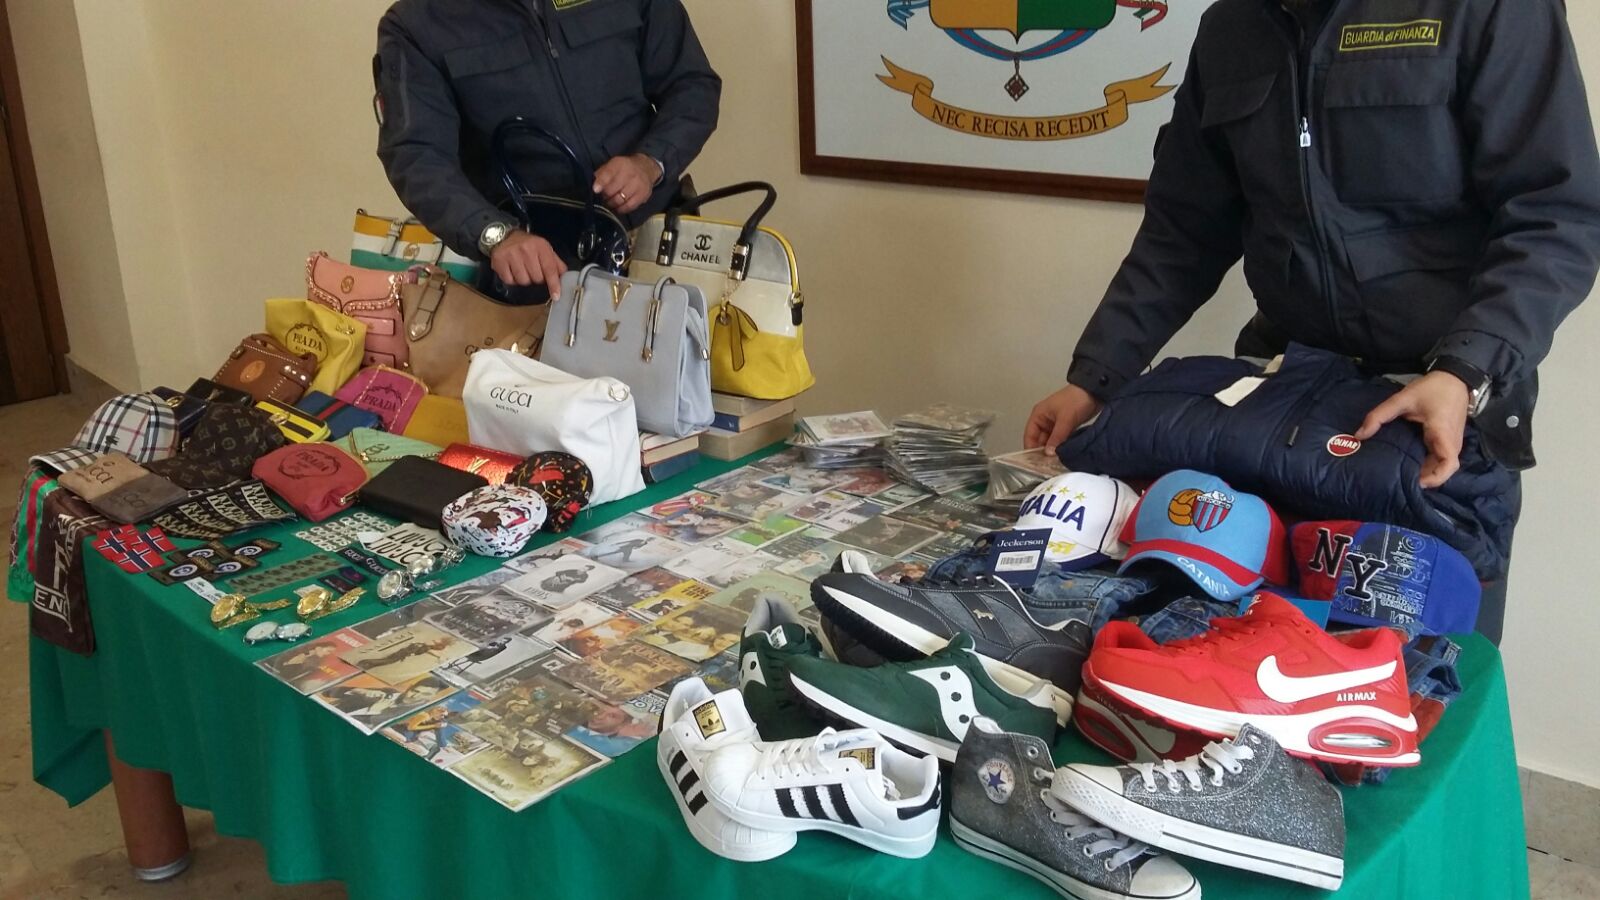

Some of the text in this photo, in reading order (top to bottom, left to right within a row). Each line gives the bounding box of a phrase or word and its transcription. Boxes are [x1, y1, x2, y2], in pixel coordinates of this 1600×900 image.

[1345, 26, 1434, 45] GUARDIA di FINANZA
[932, 105, 1110, 138] NEC RECISA RECEDIT
[681, 251, 720, 264] CHANEL
[490, 386, 533, 408] GUCCI
[997, 538, 1044, 548] Jeckerson
[1177, 556, 1231, 597] CATANIA
